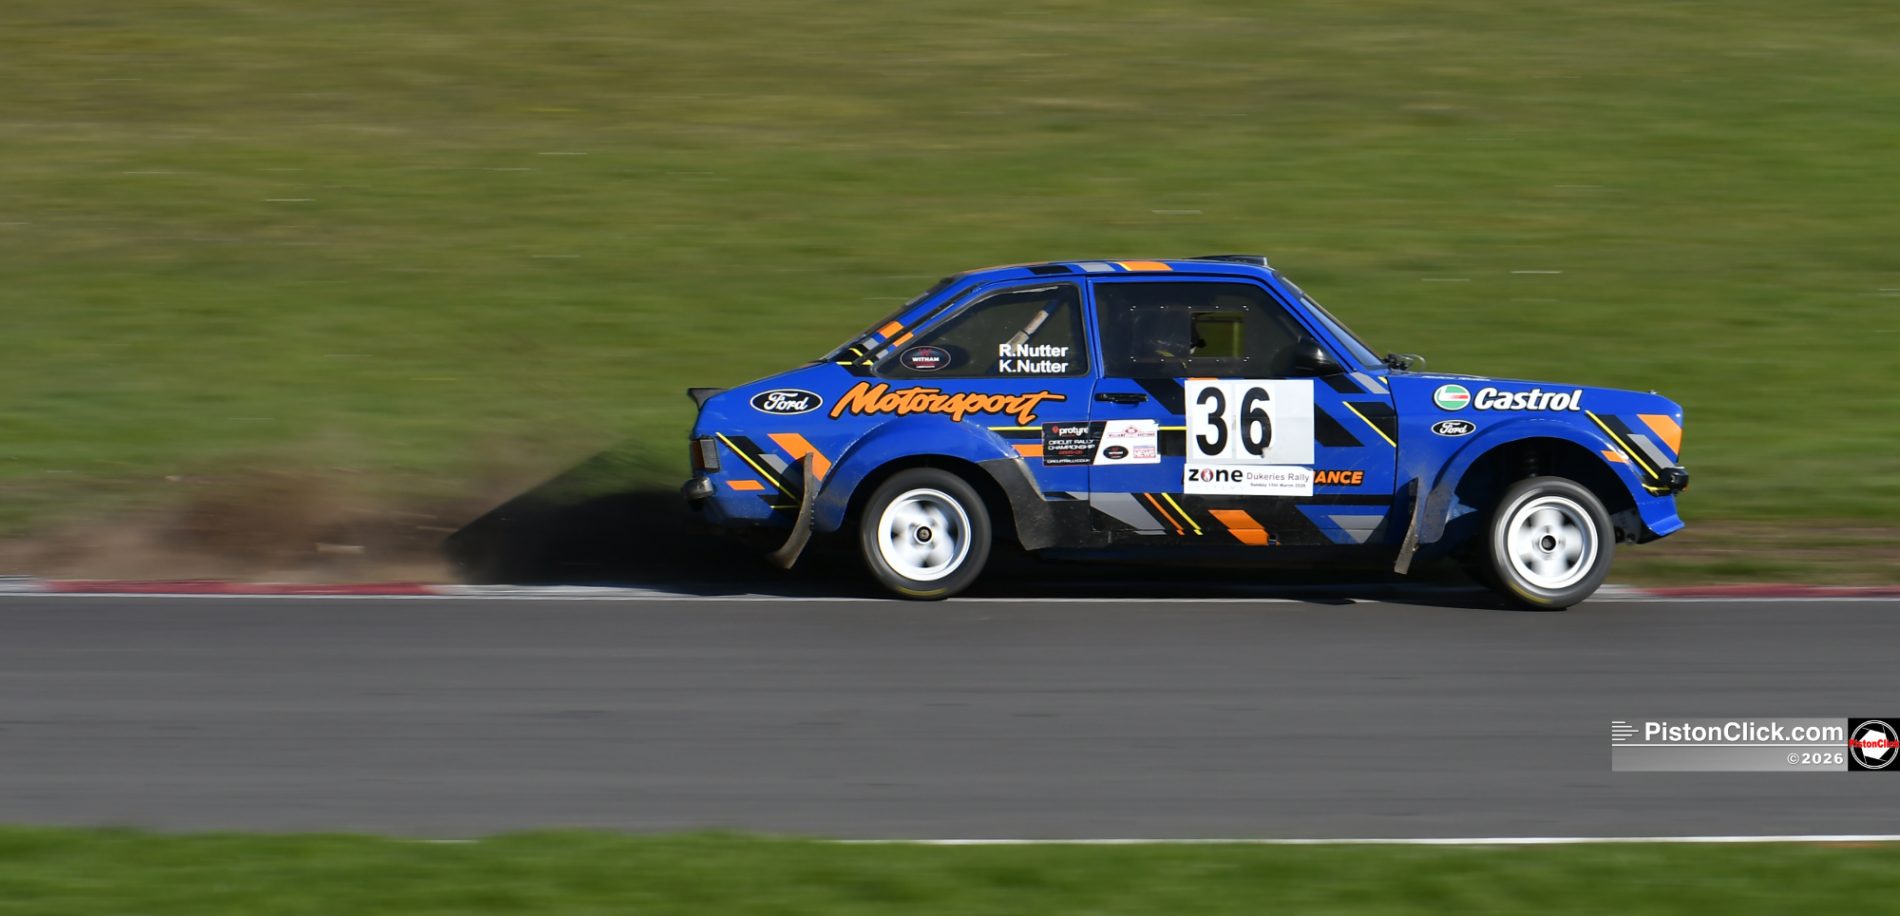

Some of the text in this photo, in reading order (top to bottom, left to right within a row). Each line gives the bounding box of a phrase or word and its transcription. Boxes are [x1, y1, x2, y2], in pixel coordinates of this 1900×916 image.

[999, 344, 1068, 357] R.Nutter
[999, 360, 1068, 373] K.Nutter
[762, 391, 809, 412] Ford
[829, 382, 1066, 426] Motorsport
[1474, 388, 1583, 411] Castrol
[1196, 386, 1272, 456] 36
[1439, 422, 1468, 435] Ford
[1188, 468, 1243, 483] zone
[1246, 472, 1310, 483] Dukeries Rally
